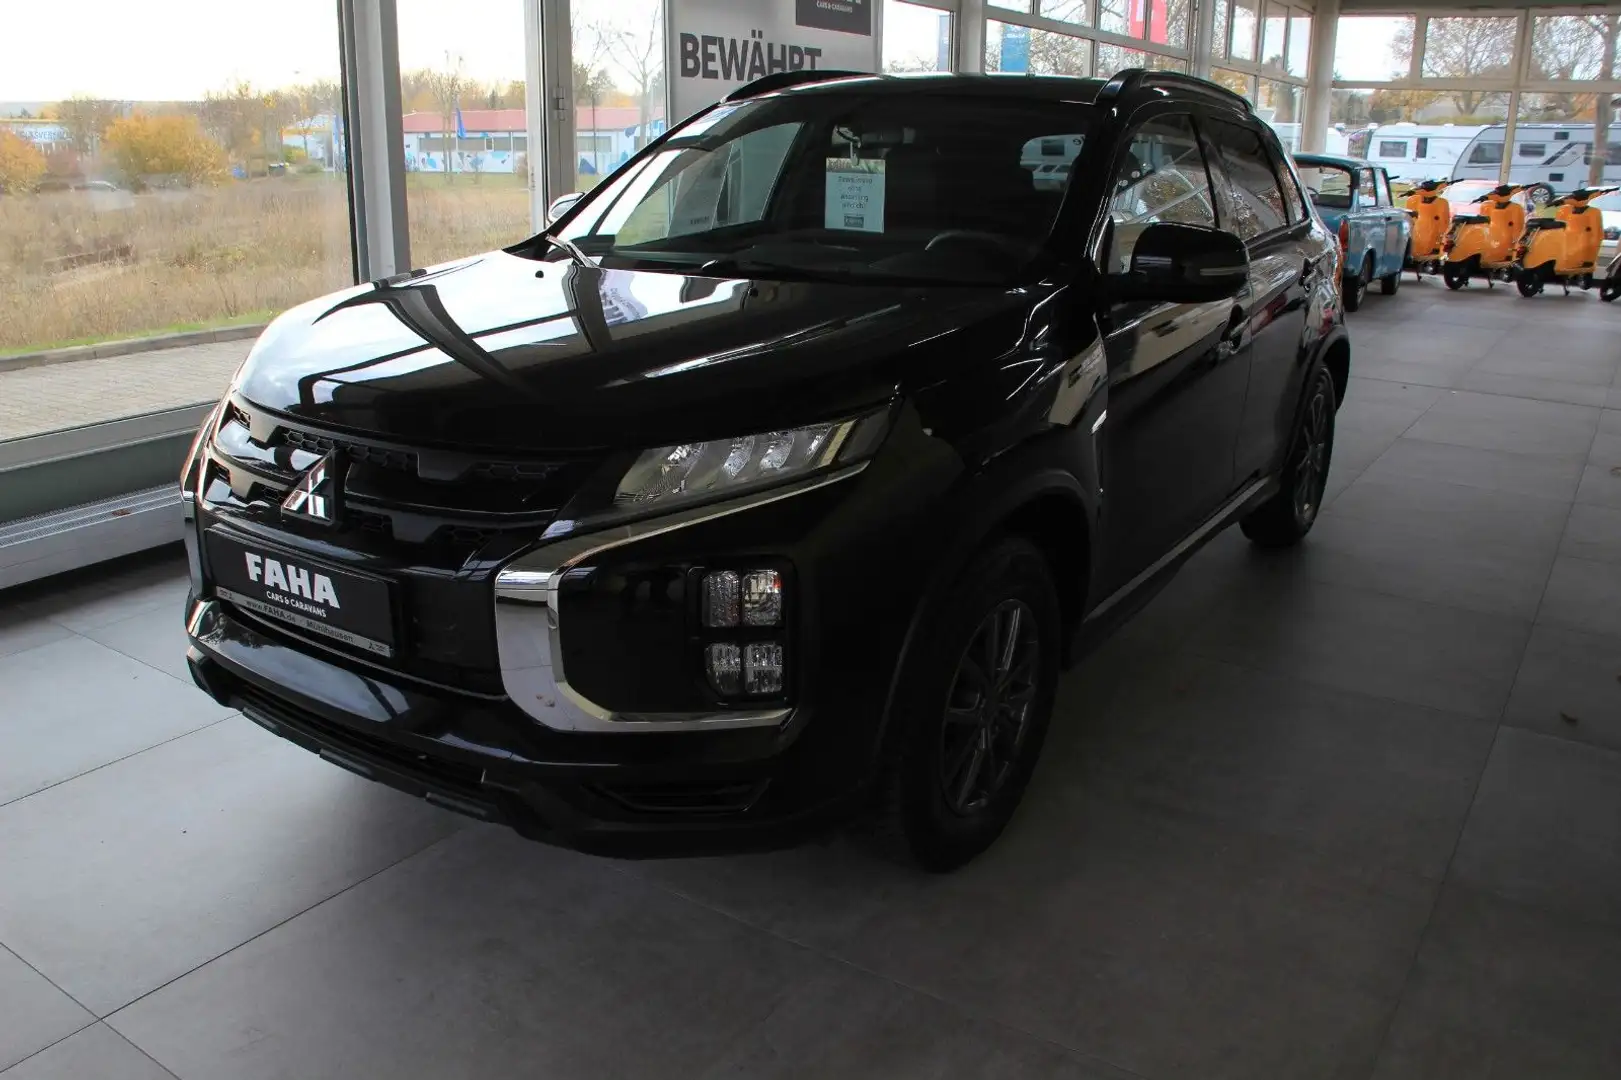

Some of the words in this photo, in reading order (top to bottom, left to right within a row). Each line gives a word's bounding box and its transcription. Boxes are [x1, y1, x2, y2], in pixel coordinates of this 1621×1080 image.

[679, 29, 822, 82] BEWÄHRT
[244, 551, 341, 609] FAHA
[246, 600, 296, 623] www.FAHA.de
[266, 590, 284, 604] CARS
[284, 596, 290, 606] &
[290, 598, 327, 619] CARAVANS
